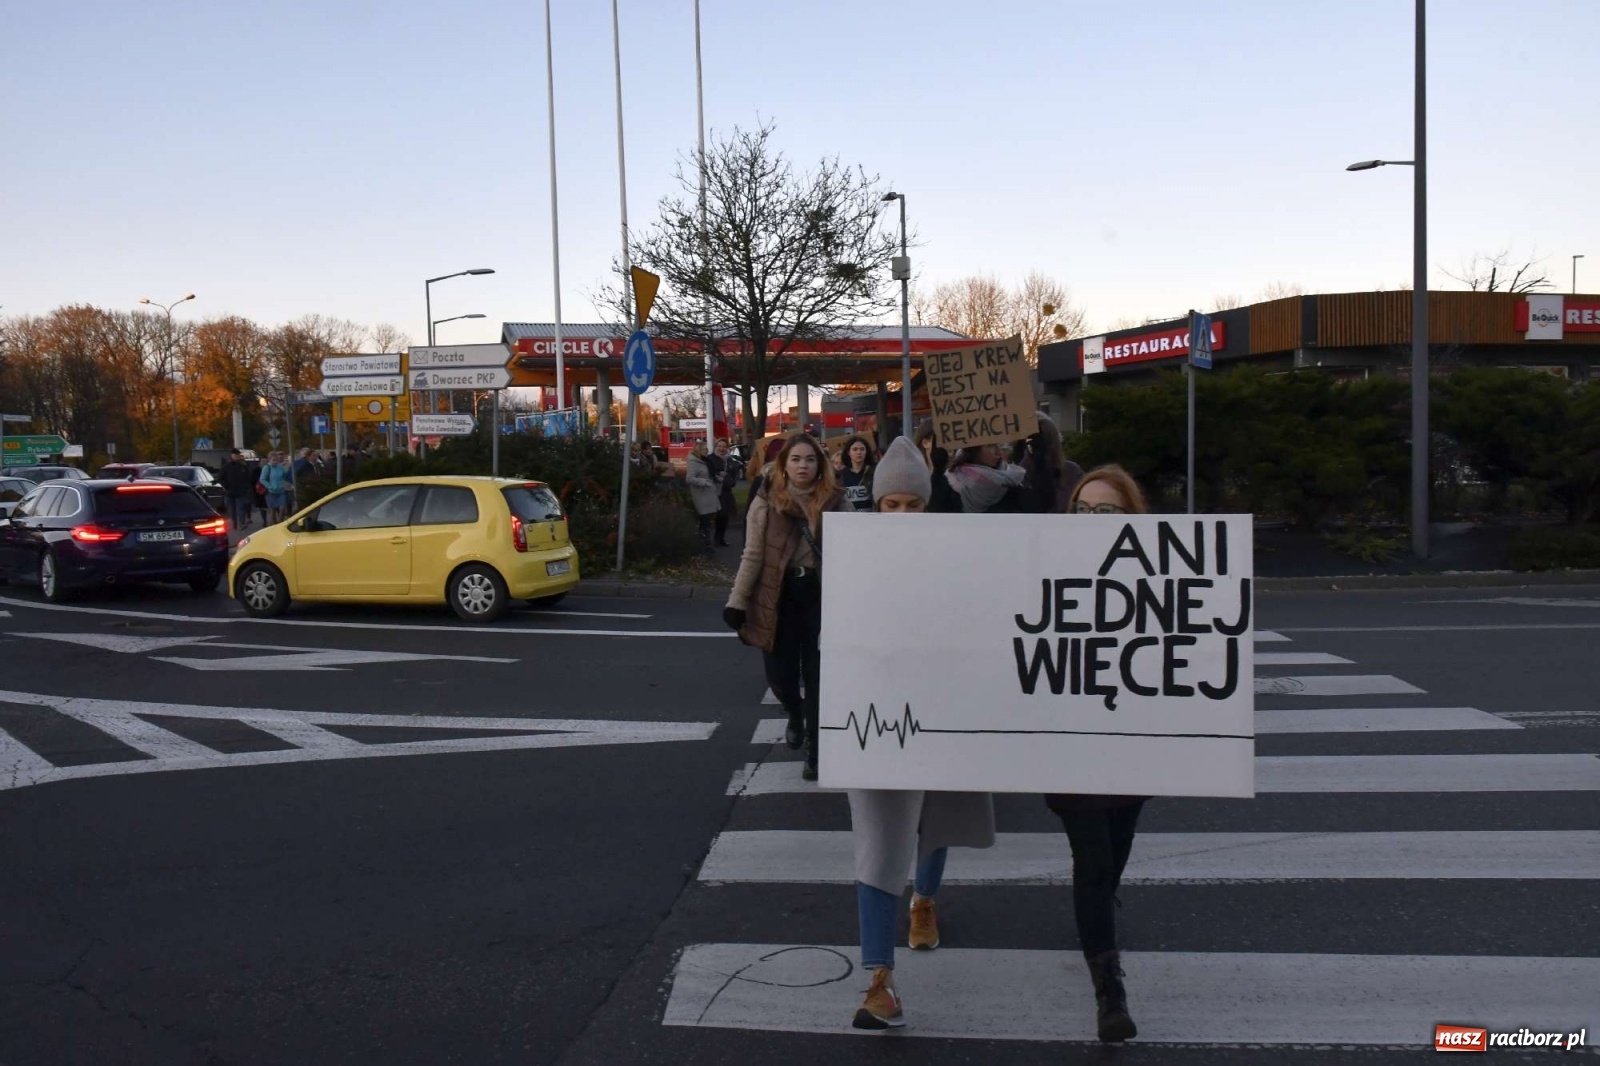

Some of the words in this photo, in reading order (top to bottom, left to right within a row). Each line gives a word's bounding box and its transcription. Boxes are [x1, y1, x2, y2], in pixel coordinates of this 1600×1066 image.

[432, 351, 465, 362] Poczta
[596, 340, 613, 356] K
[927, 352, 964, 375] JEJ
[973, 342, 1024, 370] KREW
[324, 361, 358, 372] Starostwo
[360, 360, 399, 370] Powiatowe
[432, 374, 473, 385] Dworzec
[476, 373, 496, 384] PKP
[327, 382, 352, 394] Kaplica
[354, 381, 388, 392] Zamkowa
[931, 372, 978, 397] JEST
[988, 369, 1011, 386] NA
[932, 393, 1008, 417] WASZYCH
[939, 414, 1020, 445] RĘKACH
[1098, 520, 1228, 577] ANI
[1014, 578, 1252, 636] JEDNEJ
[1013, 635, 1239, 711] WIĘCEJ
